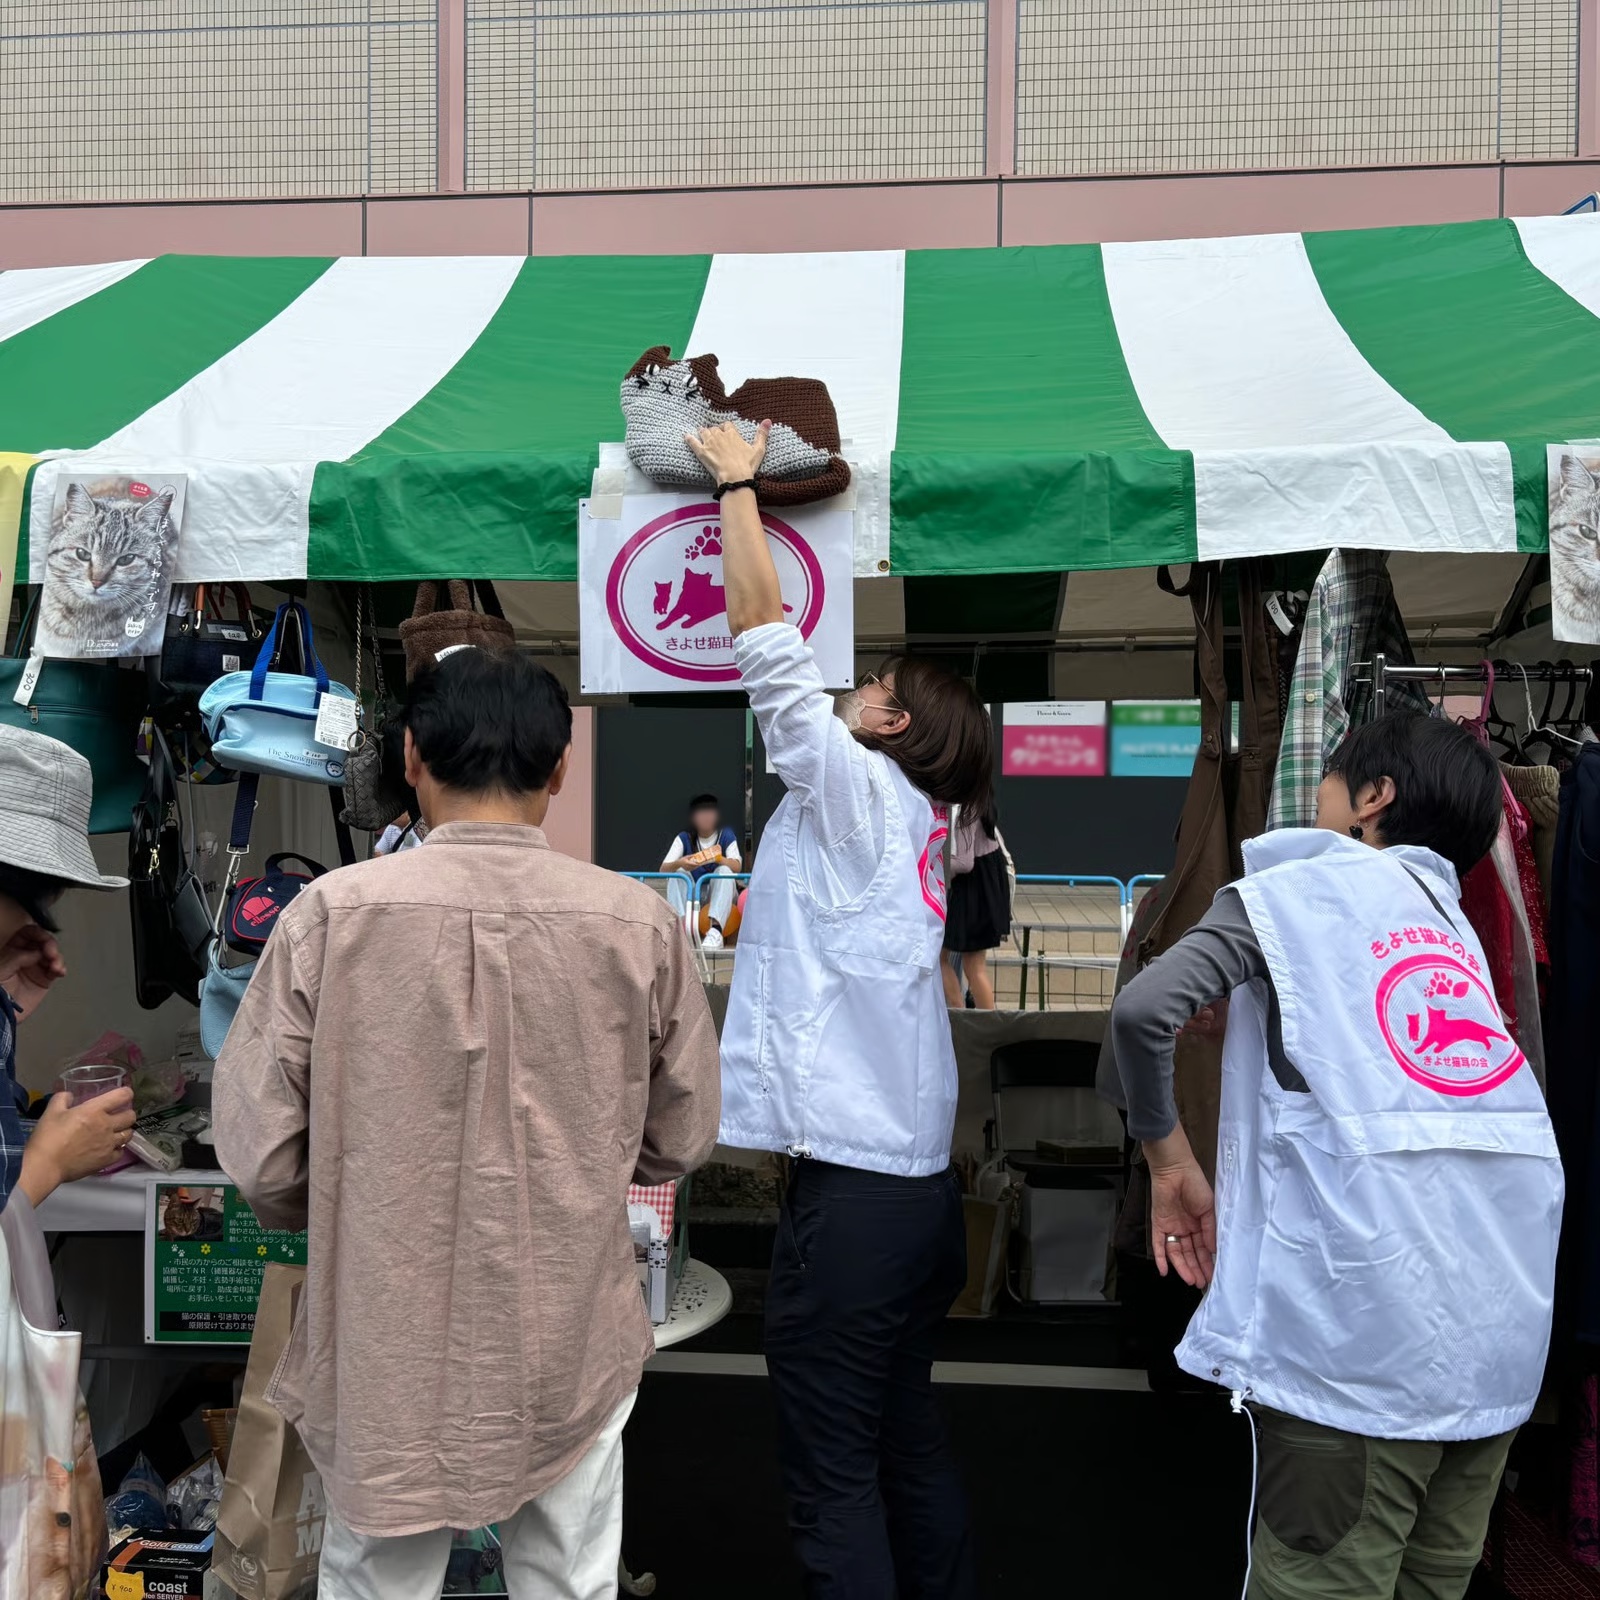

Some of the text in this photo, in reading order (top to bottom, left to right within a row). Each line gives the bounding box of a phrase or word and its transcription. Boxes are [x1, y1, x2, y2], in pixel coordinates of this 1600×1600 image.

[268, 747, 281, 757] The
[250, 905, 281, 926] ellesse
[1369, 926, 1482, 975] きよせ猫耳の会
[1423, 1055, 1489, 1069] きよせ猫耳の会
[139, 1539, 169, 1549] Gold
[119, 1585, 133, 1593] 900
[148, 1581, 189, 1594] coast
